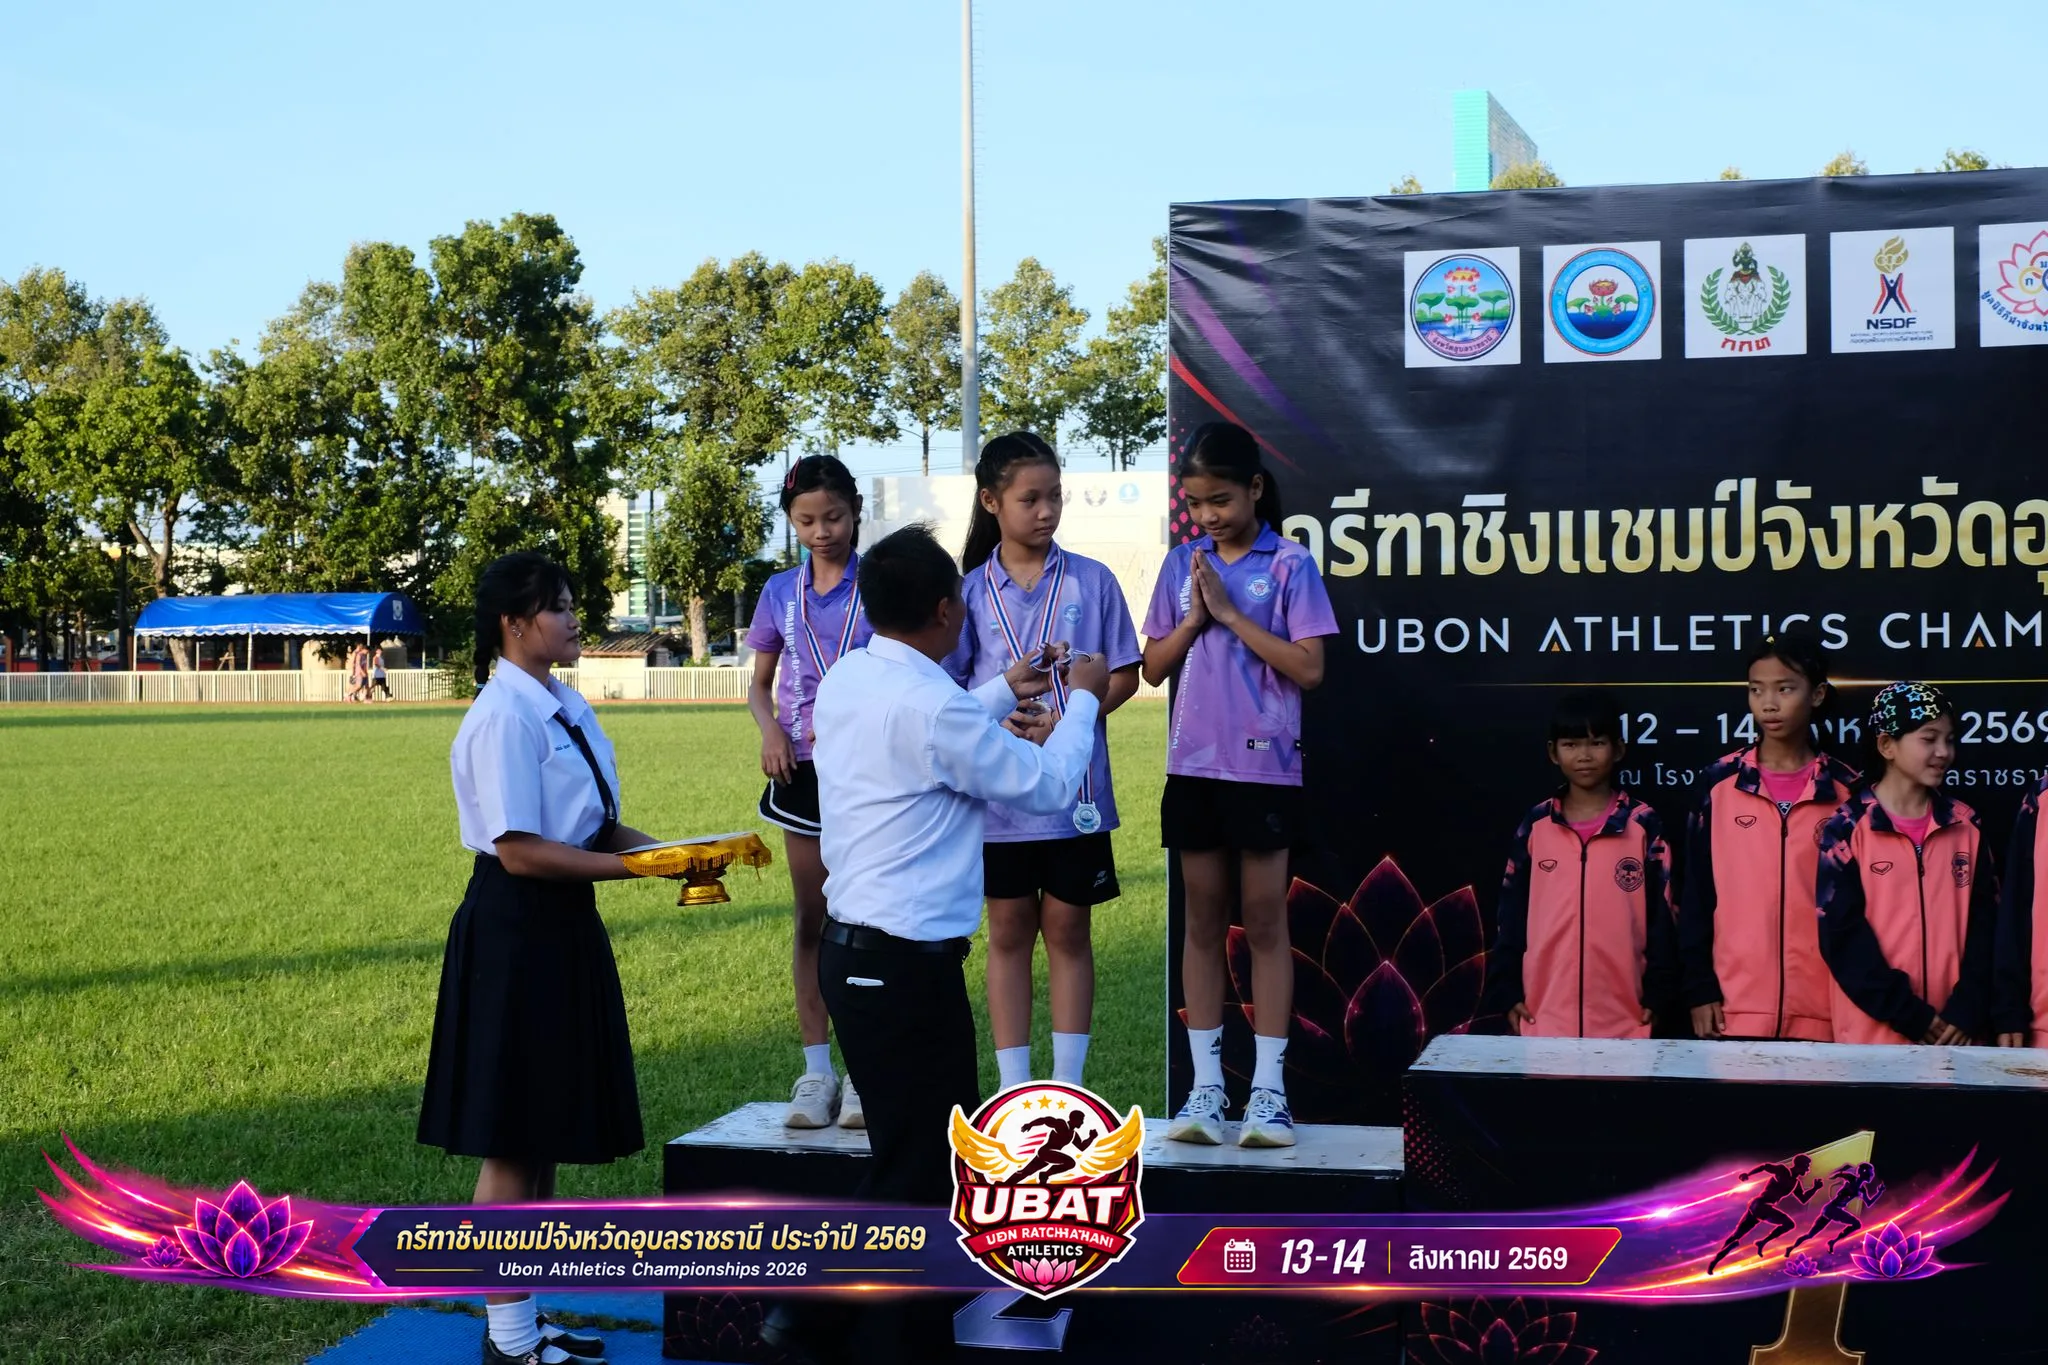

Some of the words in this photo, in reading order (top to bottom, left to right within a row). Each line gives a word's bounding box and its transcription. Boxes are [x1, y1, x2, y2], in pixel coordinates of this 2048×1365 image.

[1866, 317, 1917, 330] NSDF
[1721, 336, 1772, 352] กกท
[1357, 617, 1510, 654] UBON
[1619, 712, 1658, 744] 12
[1716, 712, 1758, 744] 14
